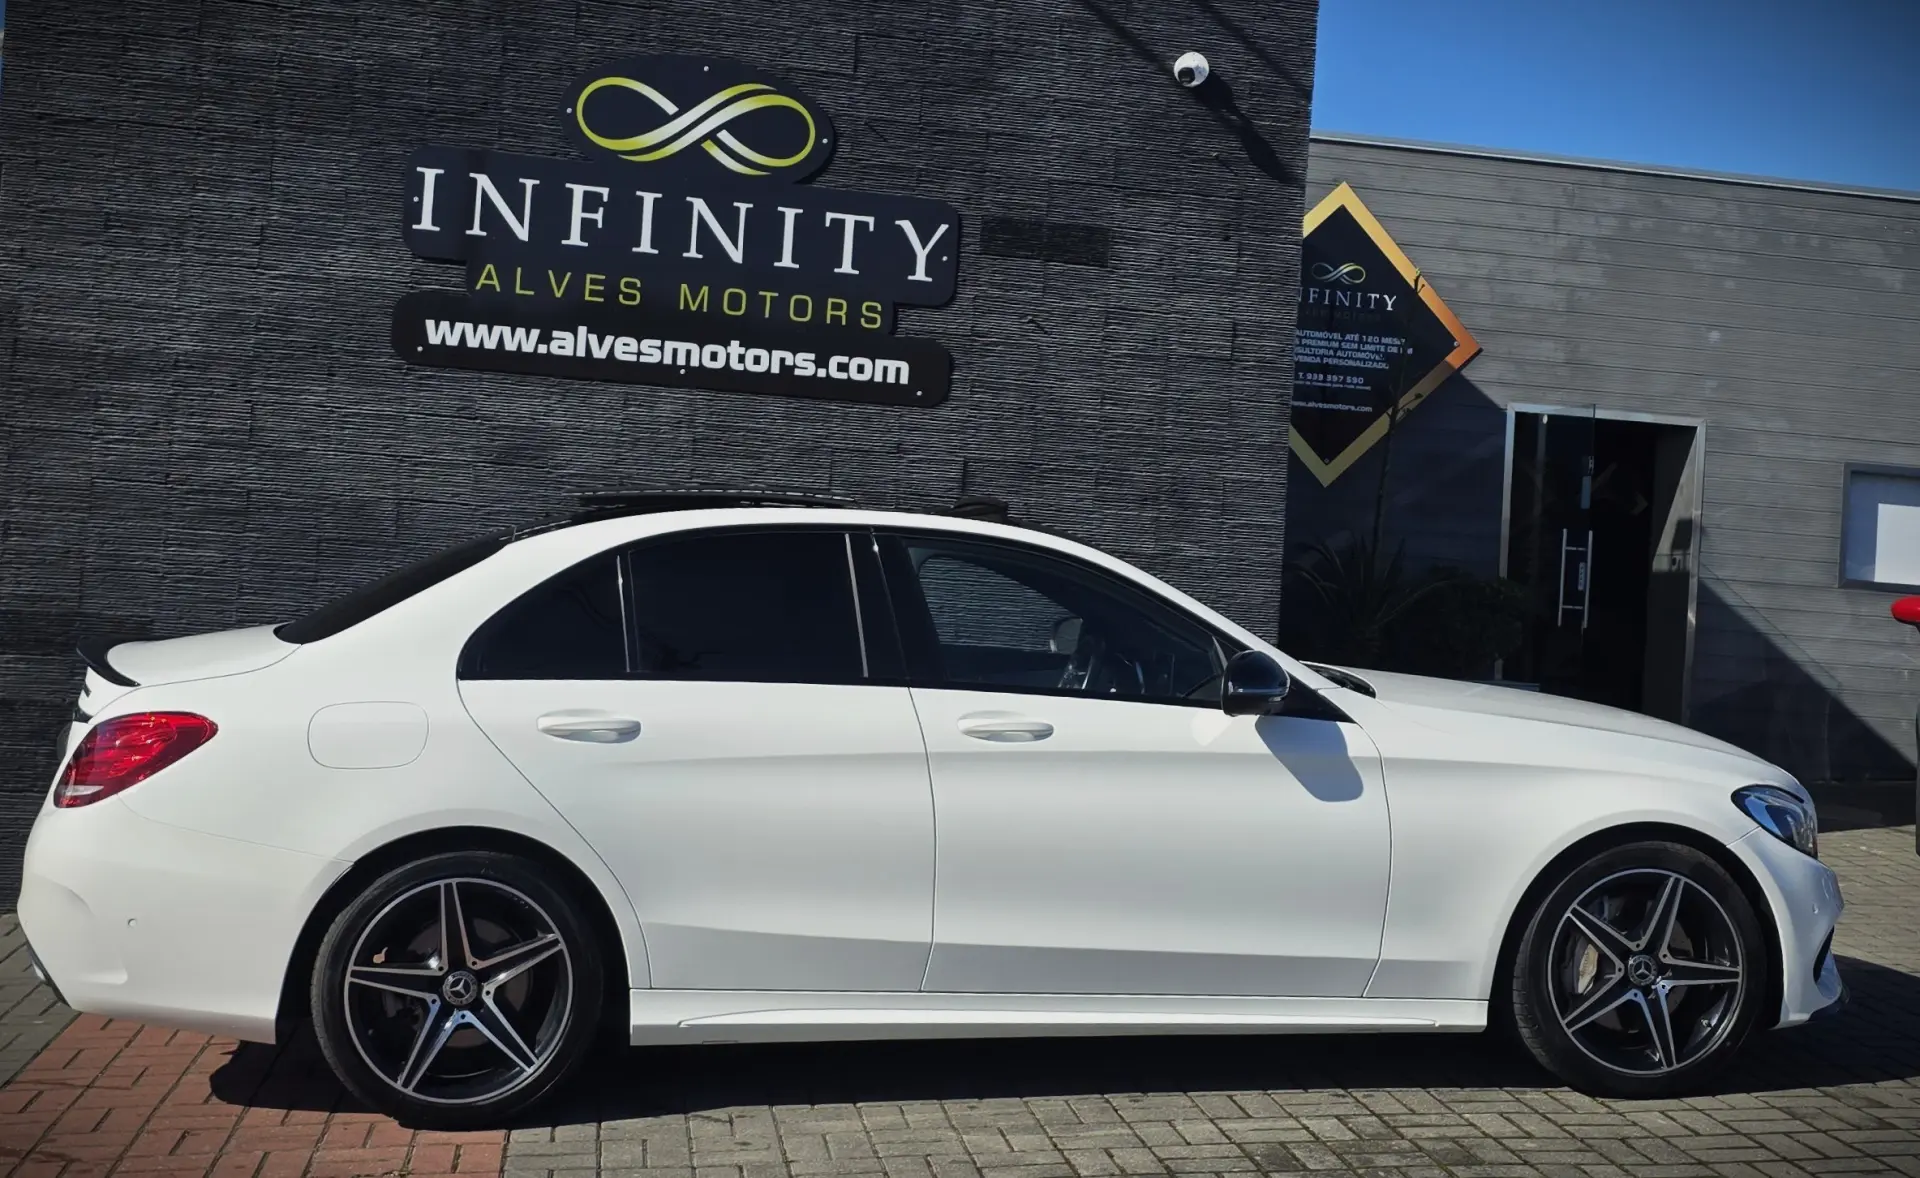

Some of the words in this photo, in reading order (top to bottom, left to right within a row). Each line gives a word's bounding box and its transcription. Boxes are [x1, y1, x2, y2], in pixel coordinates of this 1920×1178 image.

[412, 166, 949, 283] INFINITY
[475, 263, 642, 306] ALVES
[679, 283, 883, 329] MOTORS
[424, 319, 910, 385] www.alvesmotors.com
[1302, 338, 1339, 348] PREMIUM
